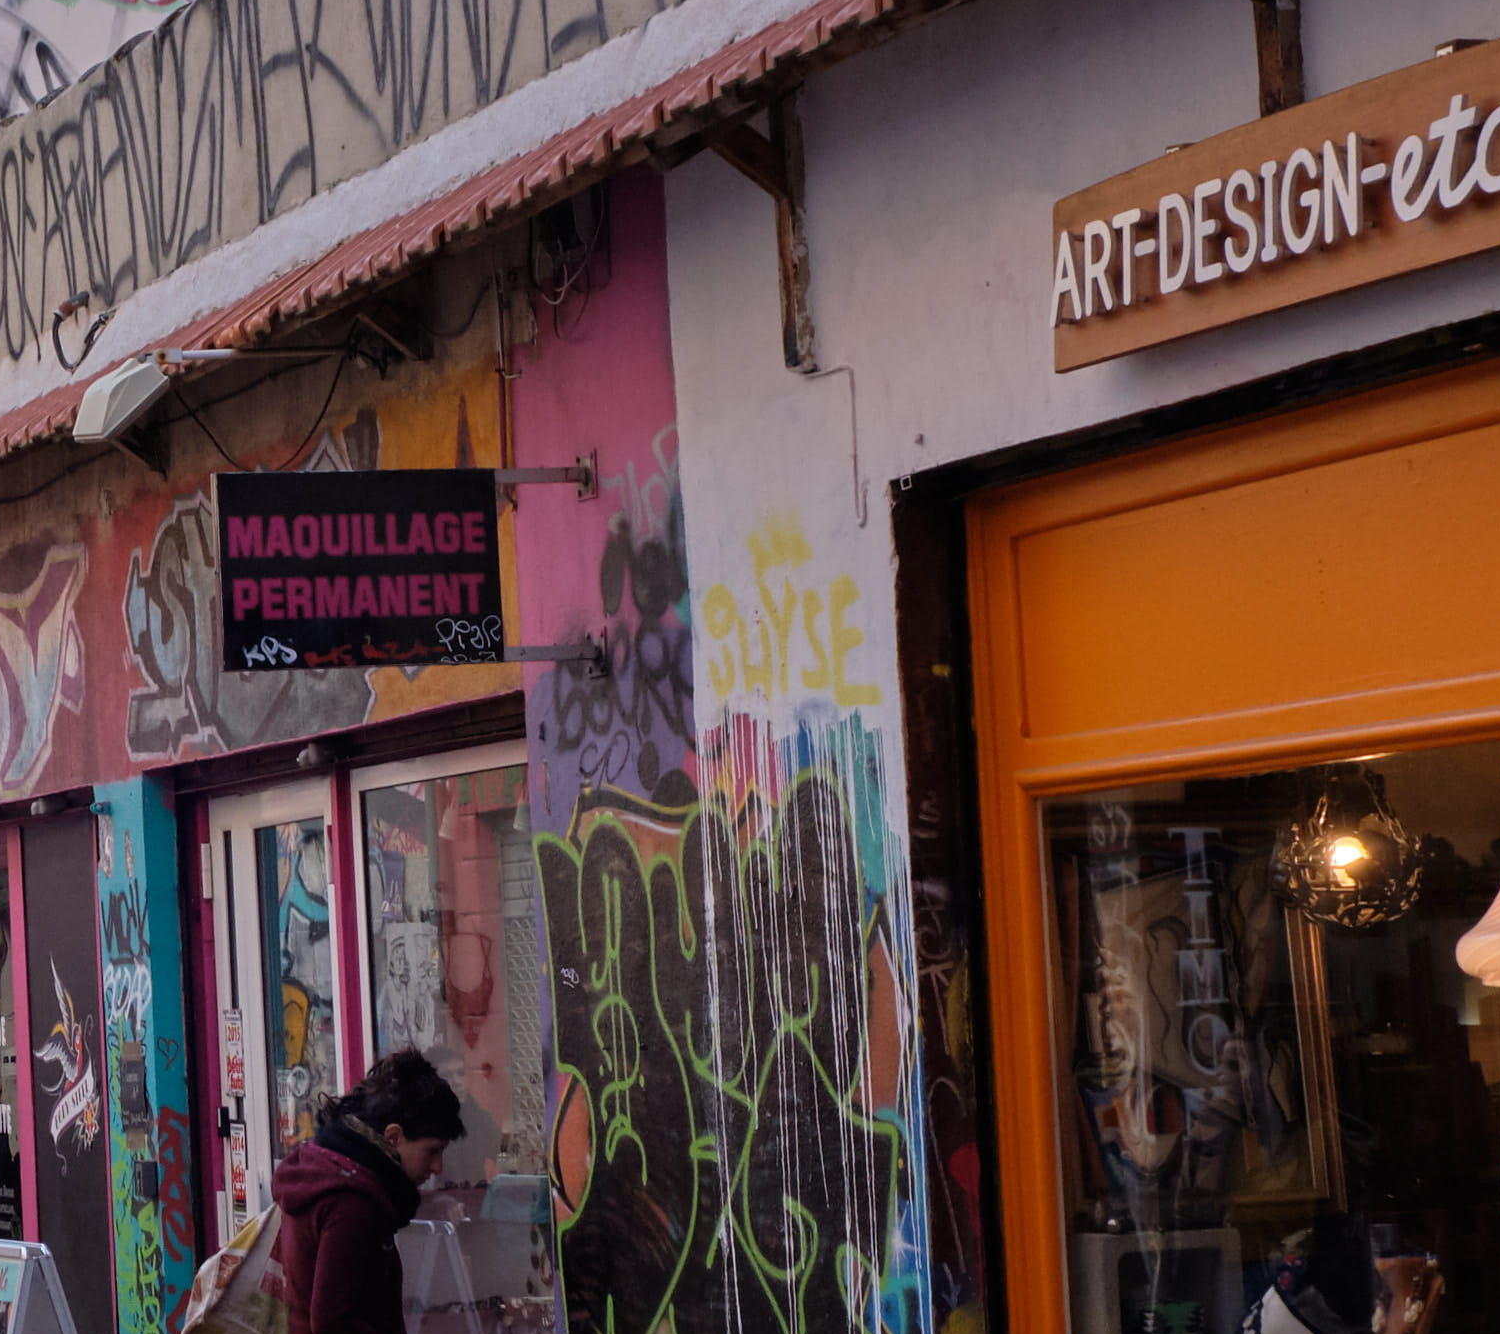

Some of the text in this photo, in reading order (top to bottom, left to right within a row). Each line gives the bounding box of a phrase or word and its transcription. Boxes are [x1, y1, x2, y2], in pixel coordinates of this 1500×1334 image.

[227, 511, 486, 559] MAQUILLAGE
[231, 572, 485, 621] PERMANENT
[230, 1131, 245, 1152] 2014
